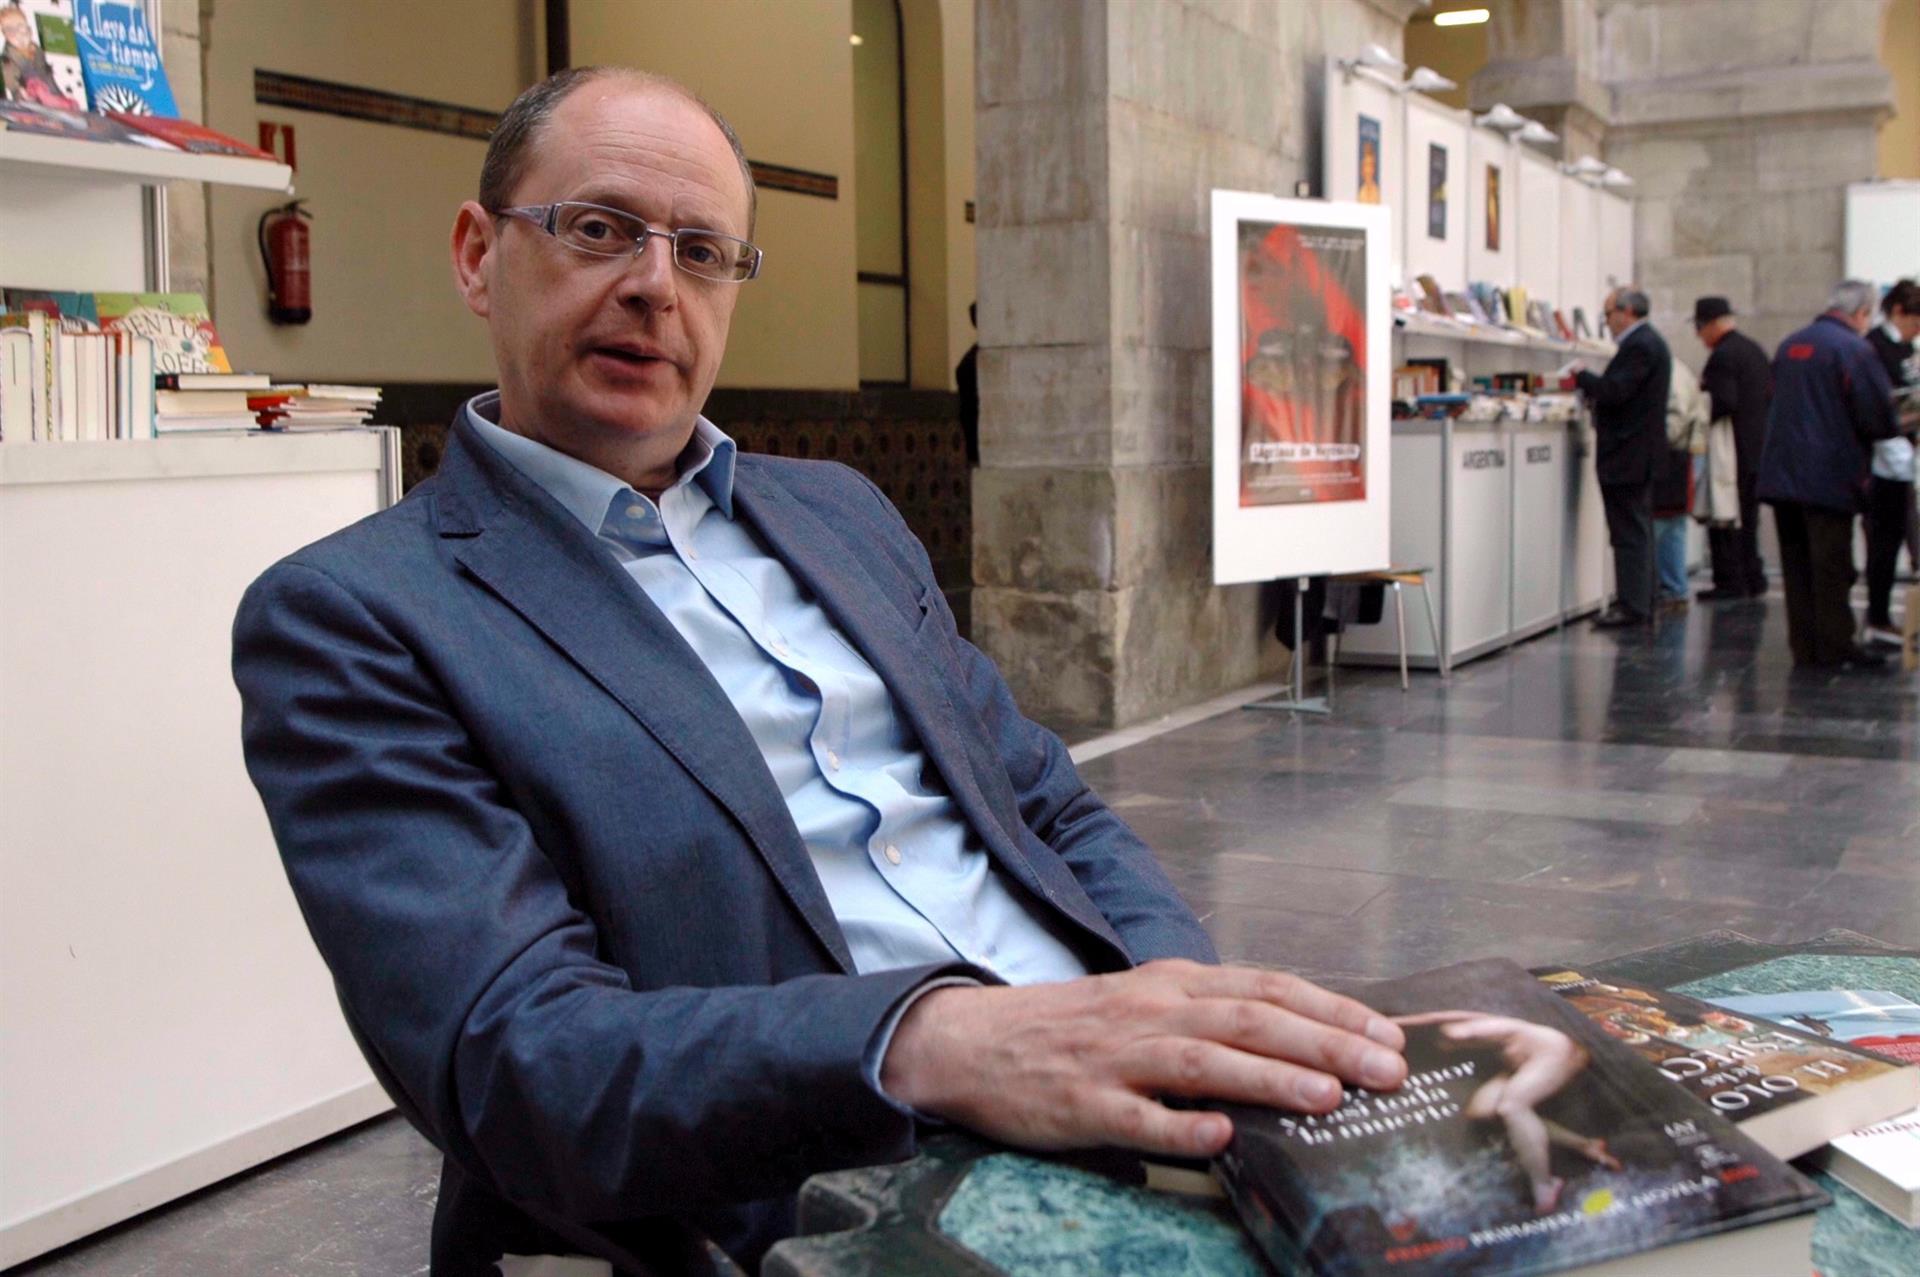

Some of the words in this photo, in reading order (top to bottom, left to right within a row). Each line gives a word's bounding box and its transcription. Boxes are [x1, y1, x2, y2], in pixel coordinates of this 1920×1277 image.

[1711, 1074, 1799, 1115] OLO
[1297, 1126, 1334, 1146] la
[1339, 1103, 1460, 1140] muerte
